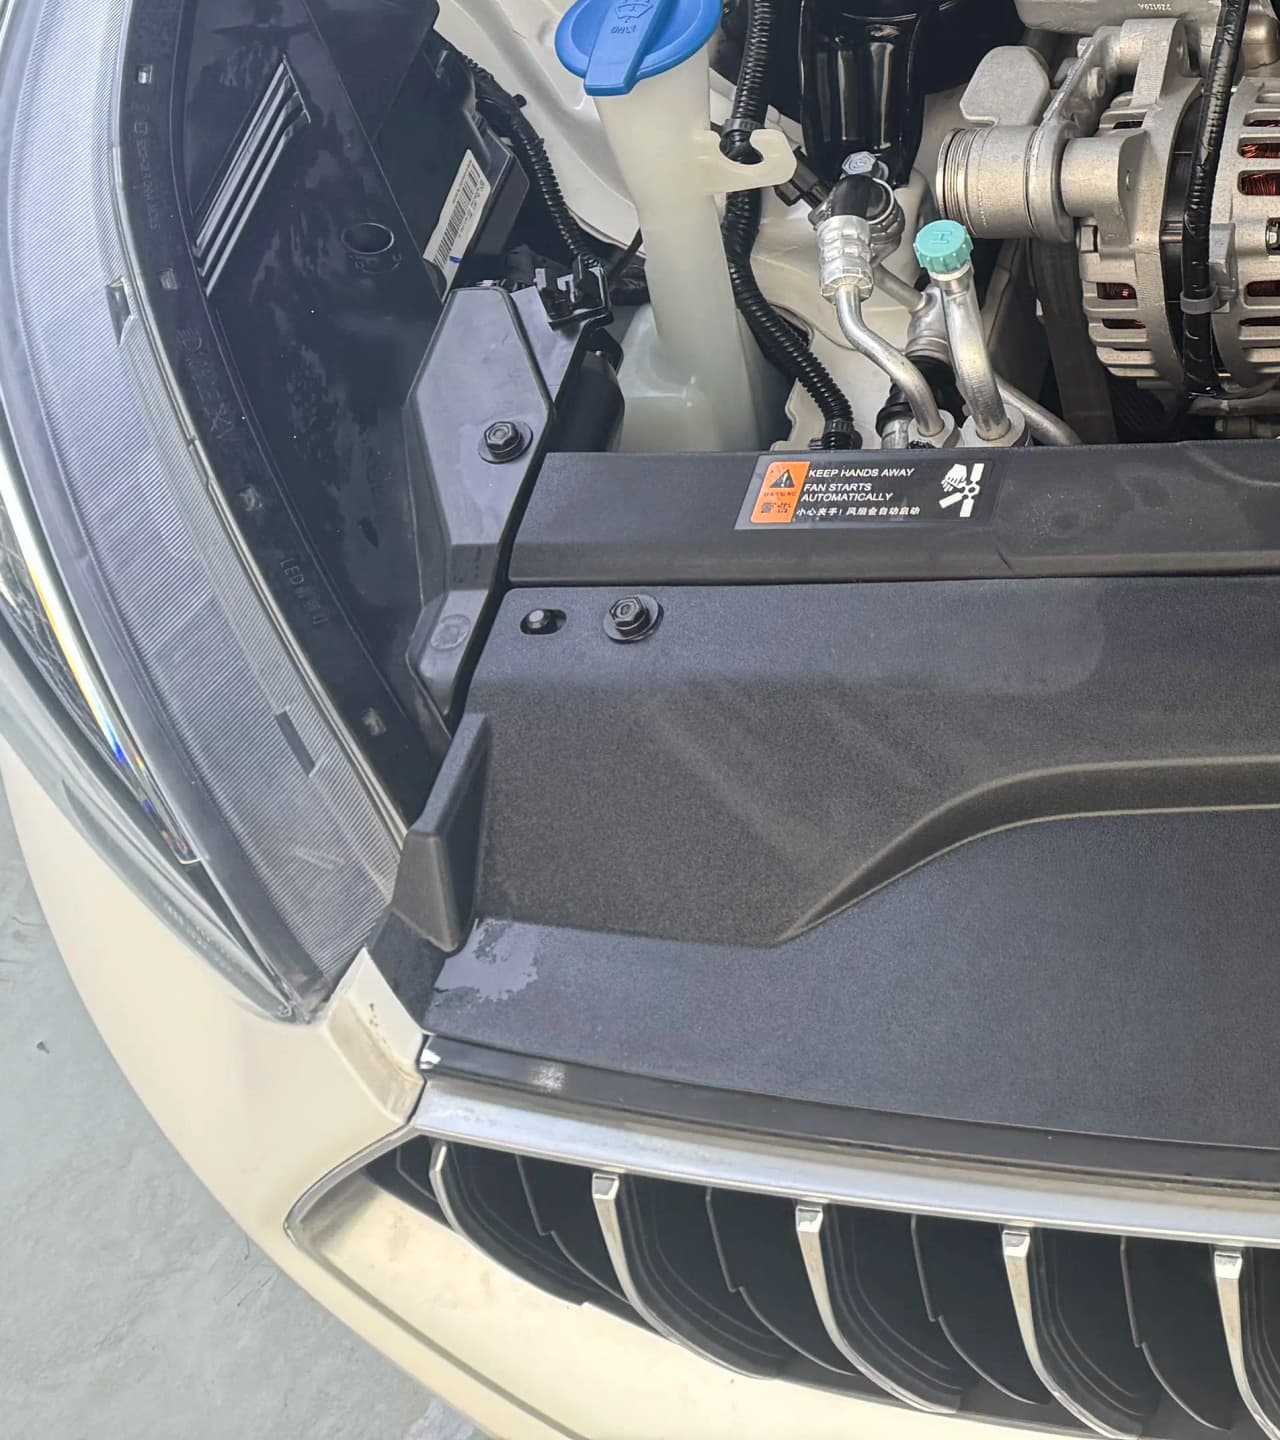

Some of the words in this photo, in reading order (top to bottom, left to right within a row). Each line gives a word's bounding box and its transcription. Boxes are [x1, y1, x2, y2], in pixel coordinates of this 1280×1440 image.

[808, 469, 838, 478] KEEP
[840, 468, 879, 477] HANDS
[881, 467, 915, 476] AWAY
[803, 483, 827, 492] FAN
[828, 482, 872, 491] STARTS
[800, 492, 894, 502] AUTOMATICALLY
